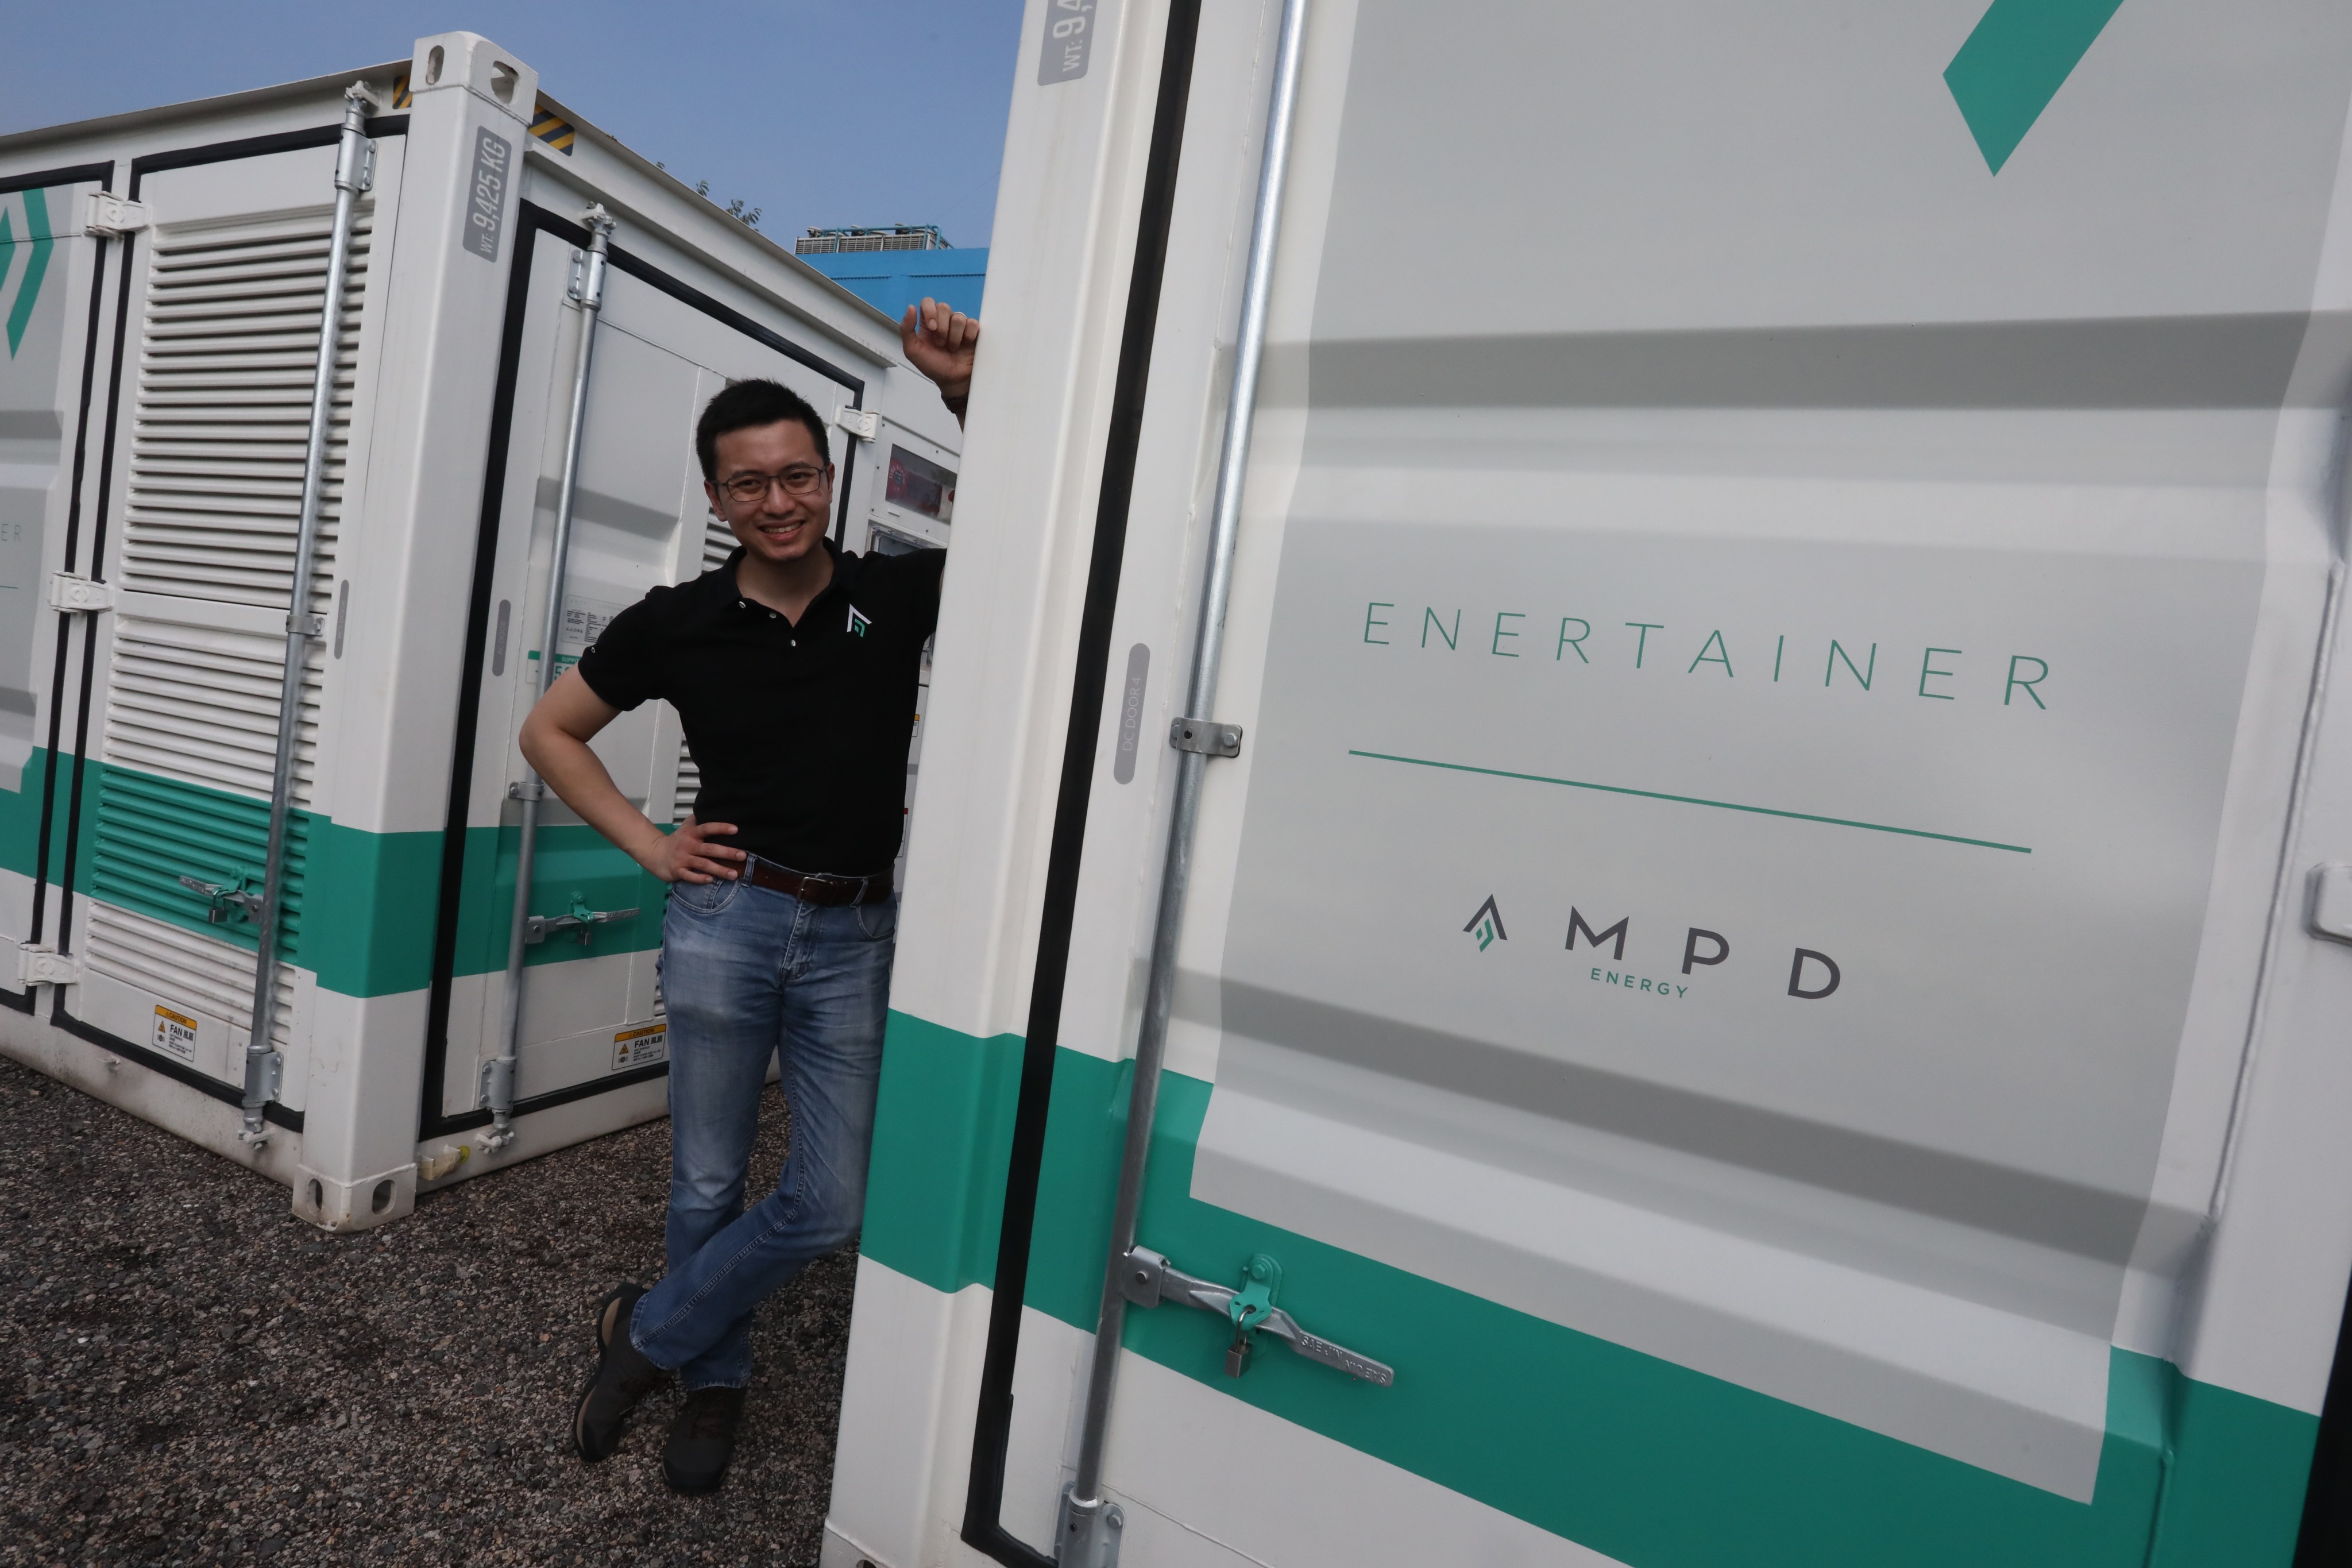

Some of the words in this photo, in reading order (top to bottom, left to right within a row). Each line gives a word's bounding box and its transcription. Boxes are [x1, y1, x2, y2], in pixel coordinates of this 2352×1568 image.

[1063, 40, 1083, 72] WT:
[481, 137, 505, 173] KG
[473, 169, 501, 231] 9,425
[480, 233, 494, 253] WT:
[1364, 602, 2050, 710] ENERTAINER
[1132, 677, 1141, 685] 4
[1125, 688, 1140, 728] DOOR
[1122, 731, 1134, 751] DC
[1590, 968, 1689, 999] ENERGY
[169, 1013, 187, 1024] CAUTION
[170, 1024, 183, 1036] FAN
[633, 1028, 654, 1036] CAUTION
[635, 1038, 650, 1048] FAN
[1301, 1336, 1323, 1352] SAE
